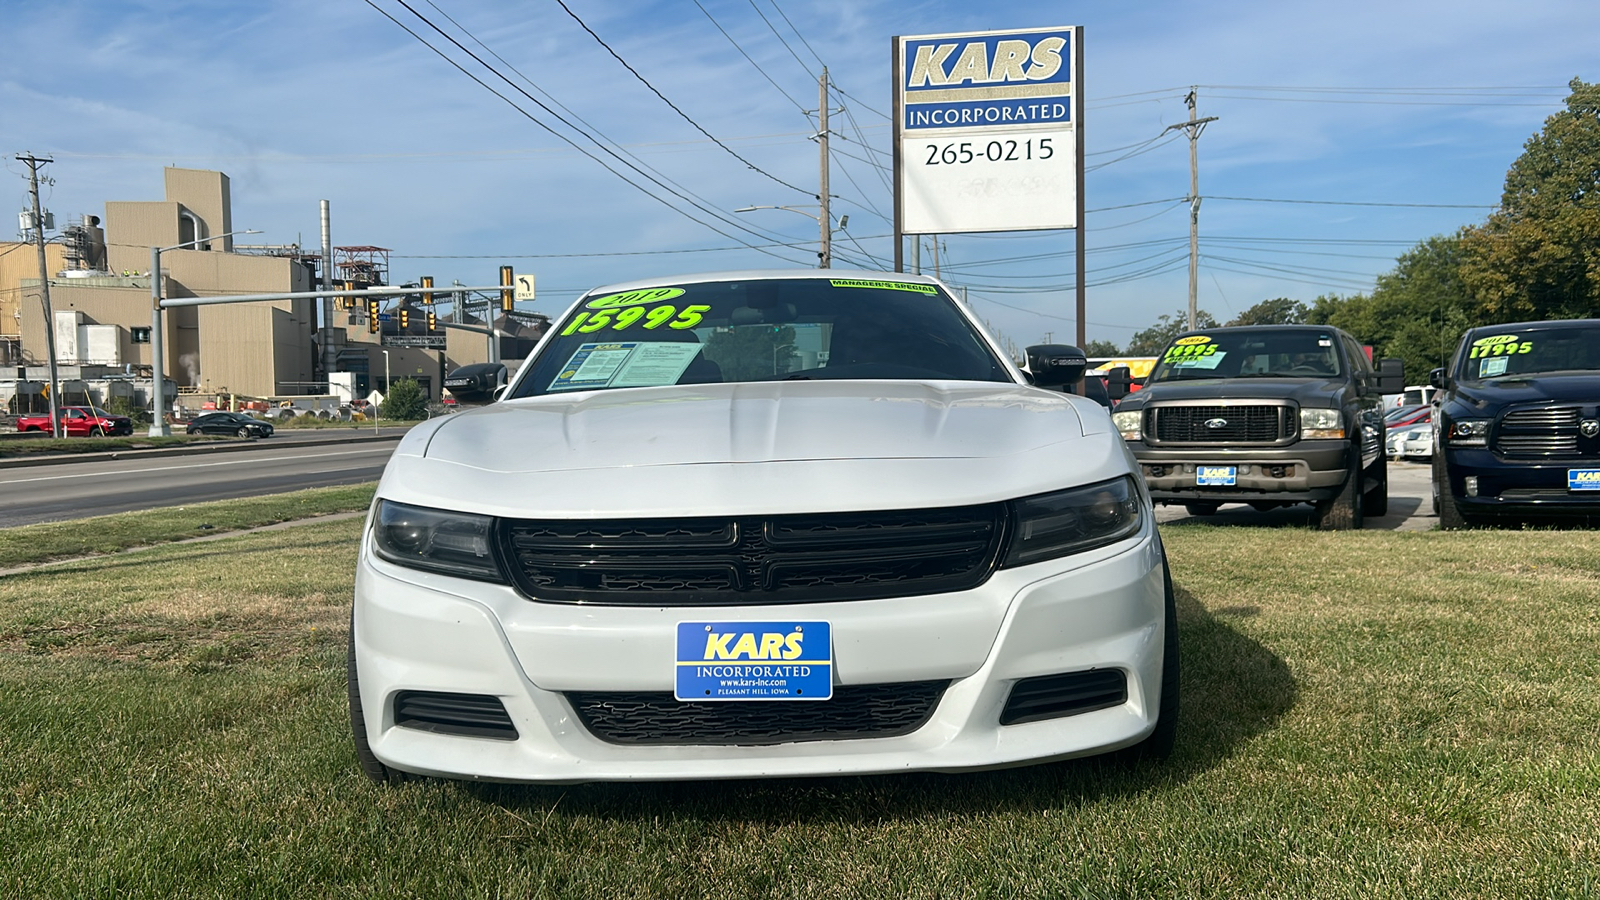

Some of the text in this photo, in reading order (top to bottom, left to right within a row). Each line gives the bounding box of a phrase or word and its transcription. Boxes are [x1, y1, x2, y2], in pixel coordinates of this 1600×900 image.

[908, 37, 1067, 87] KARS
[909, 103, 1066, 126] INCORPORATED
[925, 138, 1054, 165] 265-0215
[832, 280, 935, 292] MANAGER'S SPECIAL
[600, 289, 672, 307] 2019
[560, 305, 712, 336] 15995
[1469, 341, 1533, 358] 17995
[1576, 471, 1600, 481] KAR
[703, 632, 804, 660] KARS
[696, 666, 811, 678] INCORPORATED
